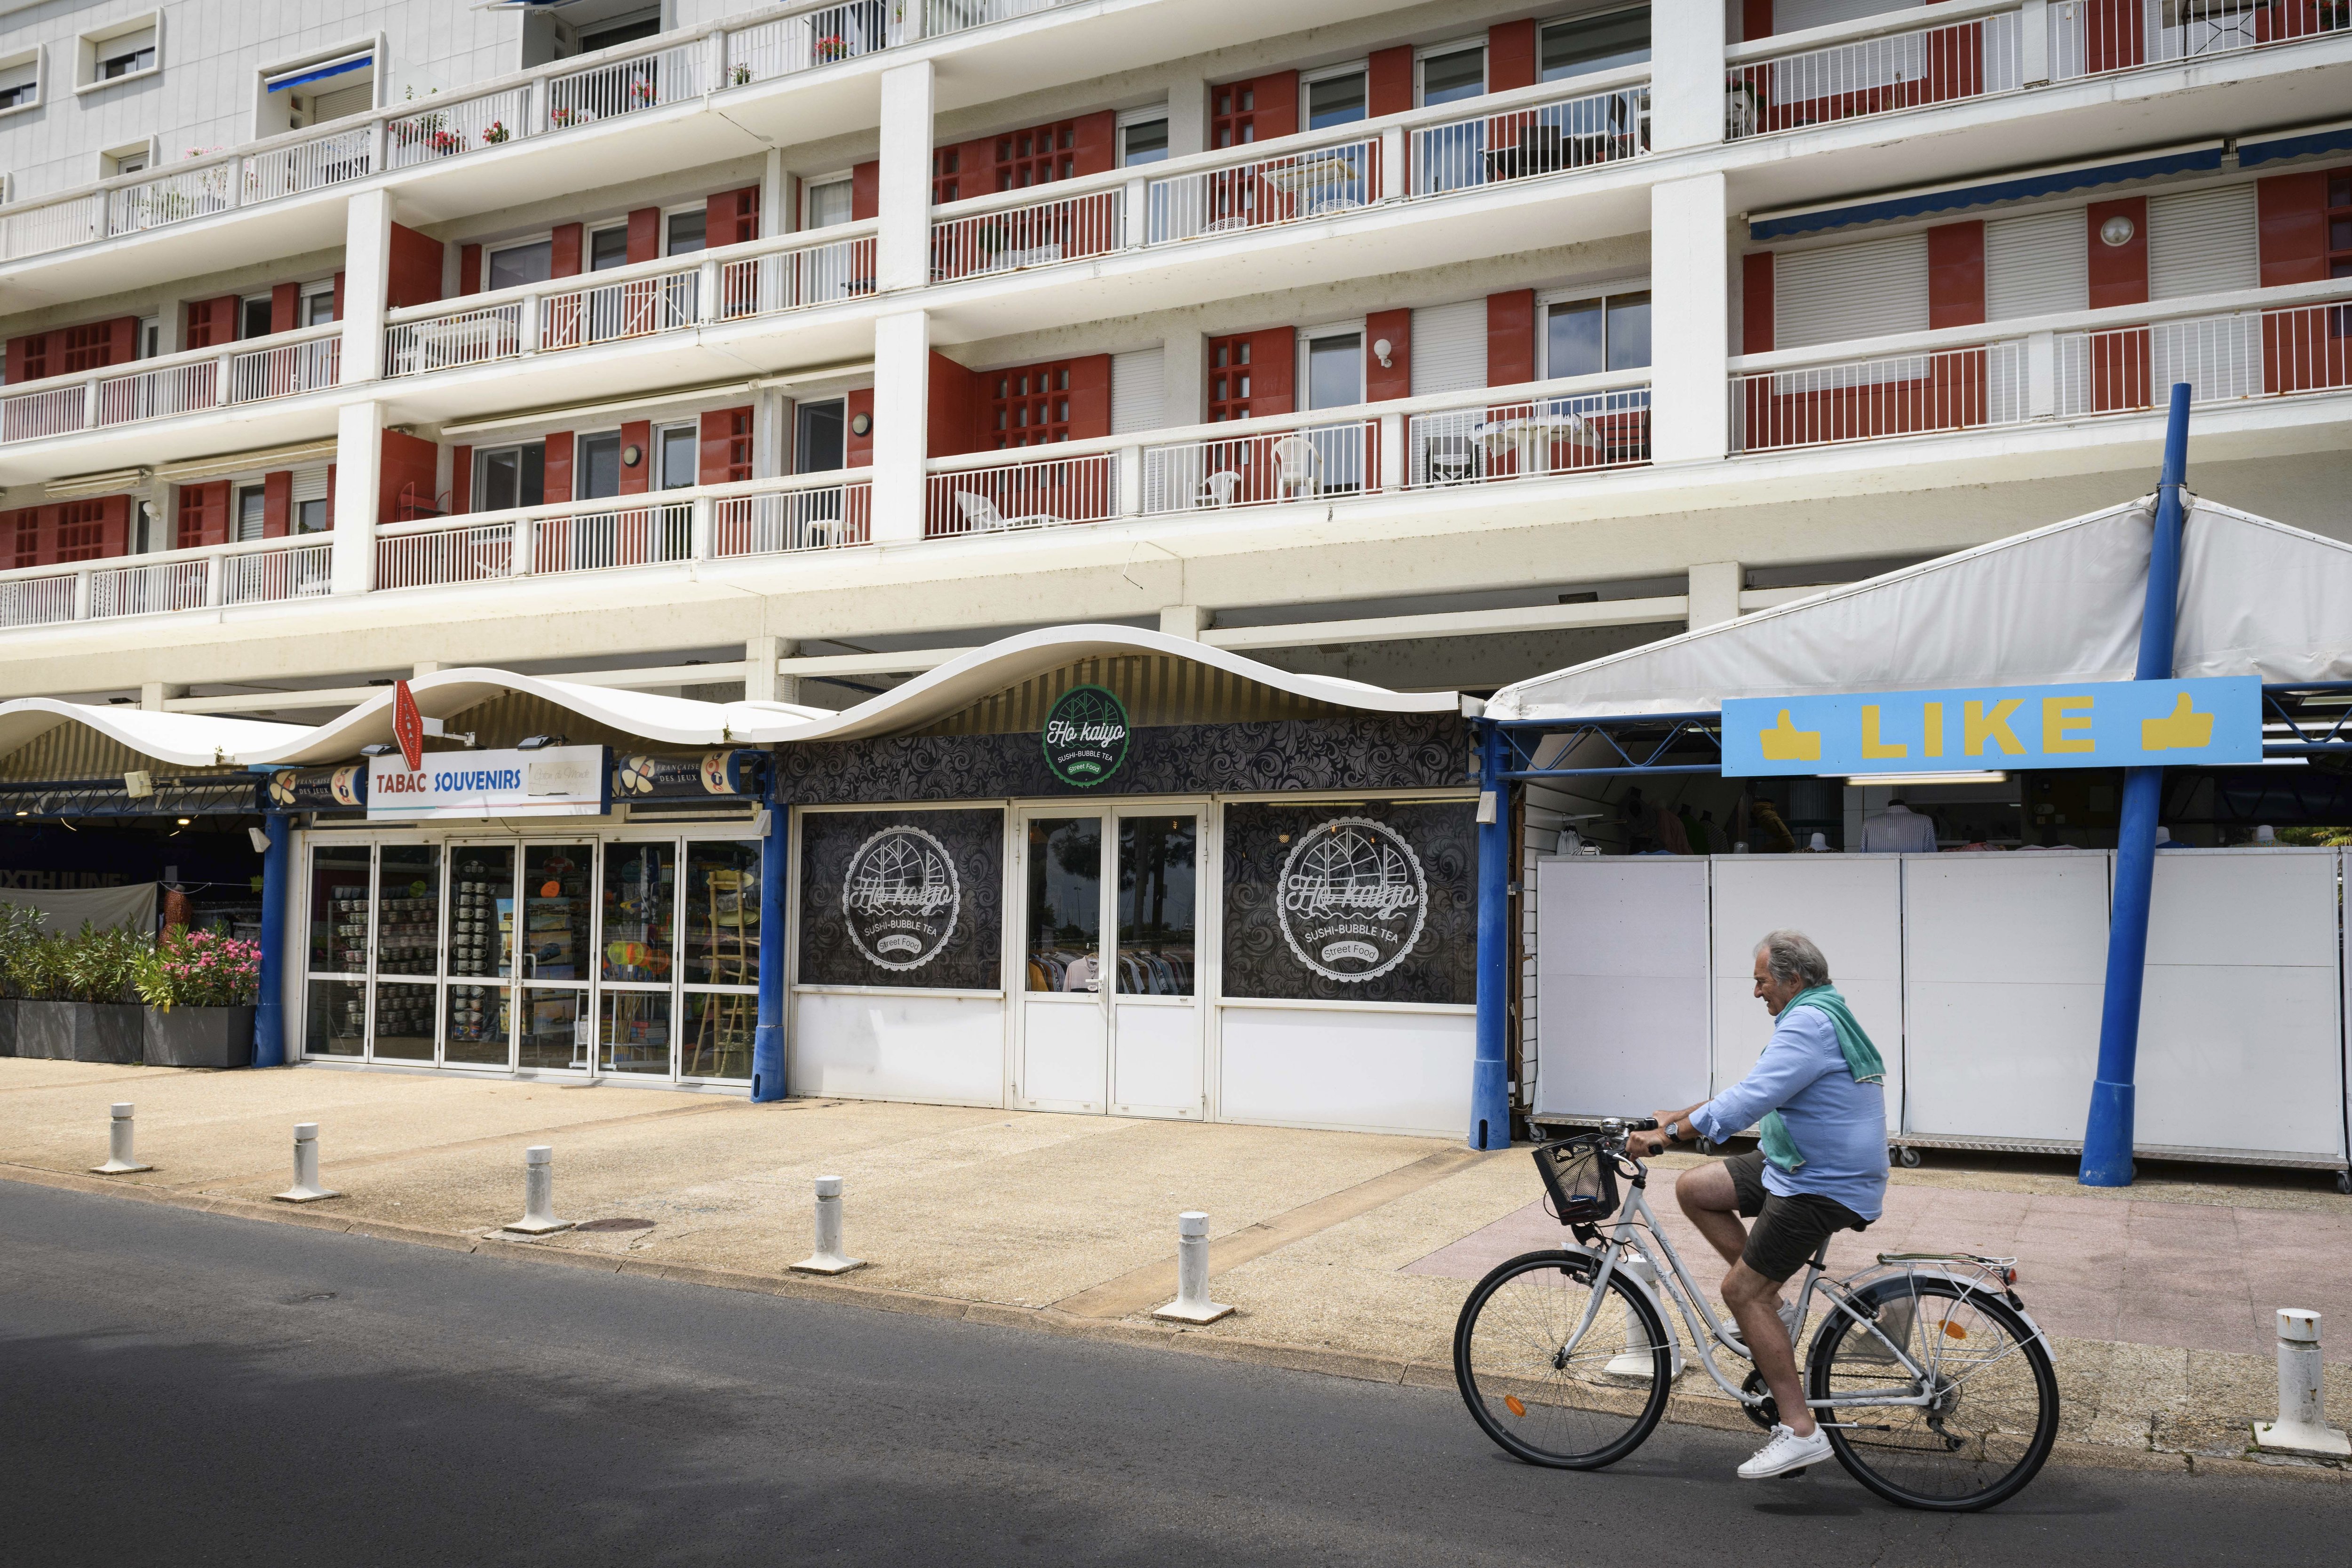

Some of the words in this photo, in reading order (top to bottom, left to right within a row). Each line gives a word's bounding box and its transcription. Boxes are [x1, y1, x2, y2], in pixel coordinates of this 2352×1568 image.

[403, 703, 415, 748] TABAC
[1047, 721, 1077, 747] Ho
[1080, 722, 1125, 748] kaiyo
[1862, 696, 2095, 759] LIKE
[1058, 750, 1101, 763] SUSHI-BUBBLE
[1102, 753, 1112, 762] TEA
[1069, 764, 1085, 772] Street
[1086, 764, 1100, 772] Food
[377, 773, 427, 793] TABAC
[434, 769, 521, 792] SOUVENIRS
[850, 876, 887, 914] Ho
[1286, 874, 1334, 916] Ho
[864, 920, 921, 936] SUSHI-BUBBLE
[923, 923, 937, 937] TEA
[1305, 924, 1378, 943] SUSHI-BUBBLE
[1381, 928, 1398, 944] TEA
[879, 938, 900, 950] Street
[902, 938, 920, 950] Food
[1324, 945, 1351, 958] Street
[1353, 945, 1376, 958] Food
[1662, 1237, 1675, 1255] Venus
